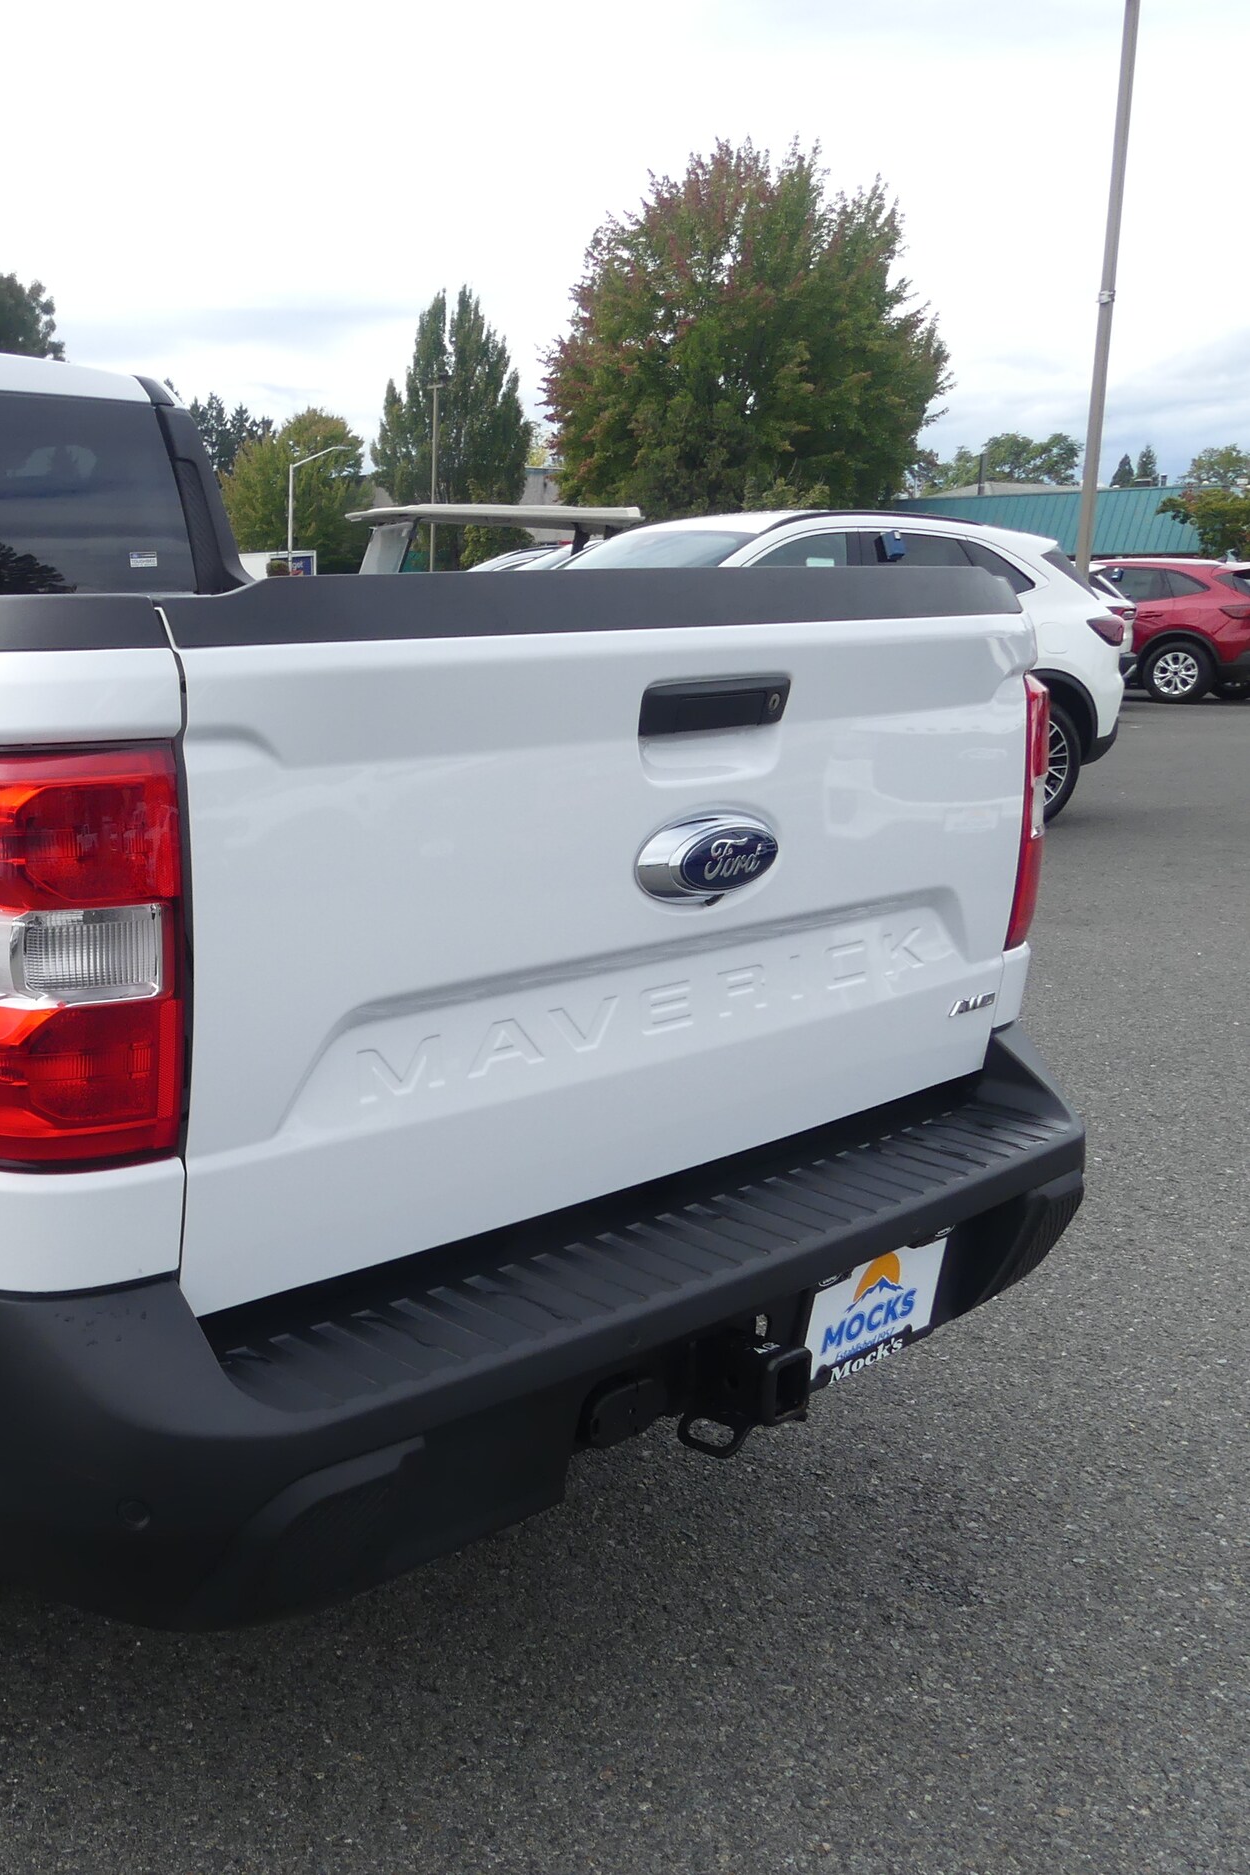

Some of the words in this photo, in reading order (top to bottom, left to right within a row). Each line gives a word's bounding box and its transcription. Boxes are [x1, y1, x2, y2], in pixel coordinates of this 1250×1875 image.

[703, 836, 762, 881] Ford
[355, 926, 925, 1104] MAVERICK
[820, 1287, 918, 1356] MOCKS
[829, 1337, 903, 1385] Mock's
